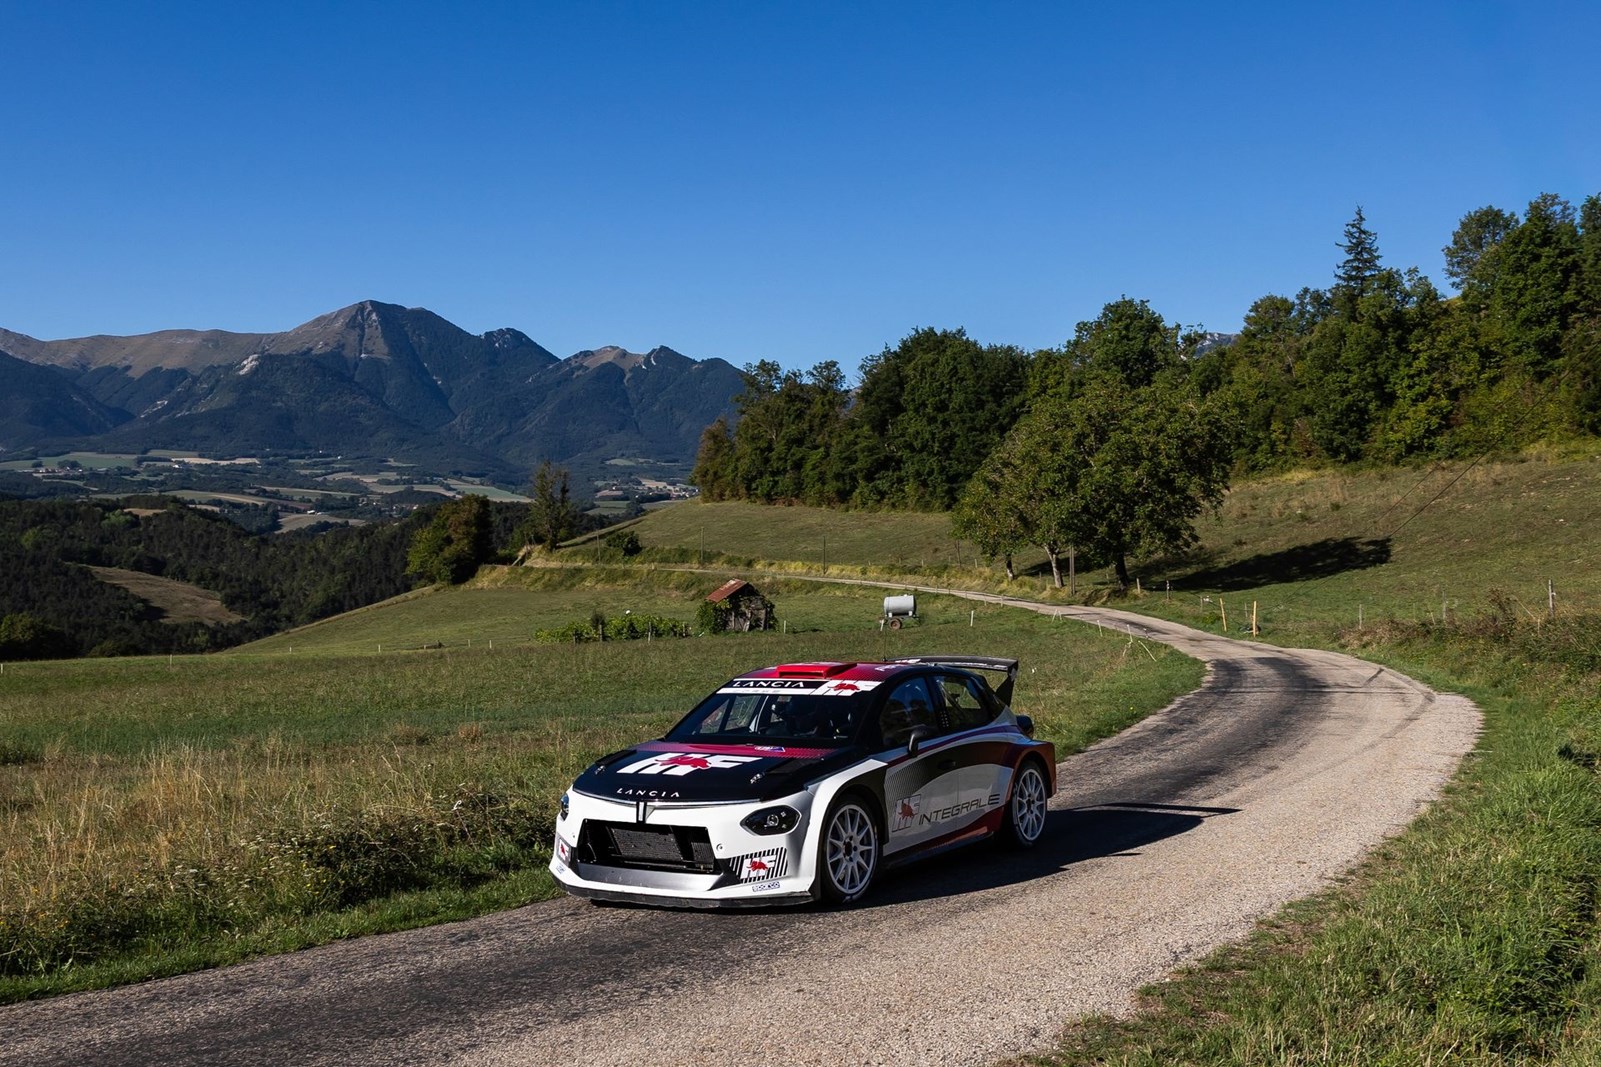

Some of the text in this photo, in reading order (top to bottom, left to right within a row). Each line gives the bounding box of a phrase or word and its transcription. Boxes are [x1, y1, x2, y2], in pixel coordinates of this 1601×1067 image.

[732, 680, 805, 688] LANCIA
[616, 752, 763, 776] HF
[616, 788, 680, 797] LANCIA
[918, 793, 1000, 825] INTEGRALE
[740, 854, 777, 880] HF
